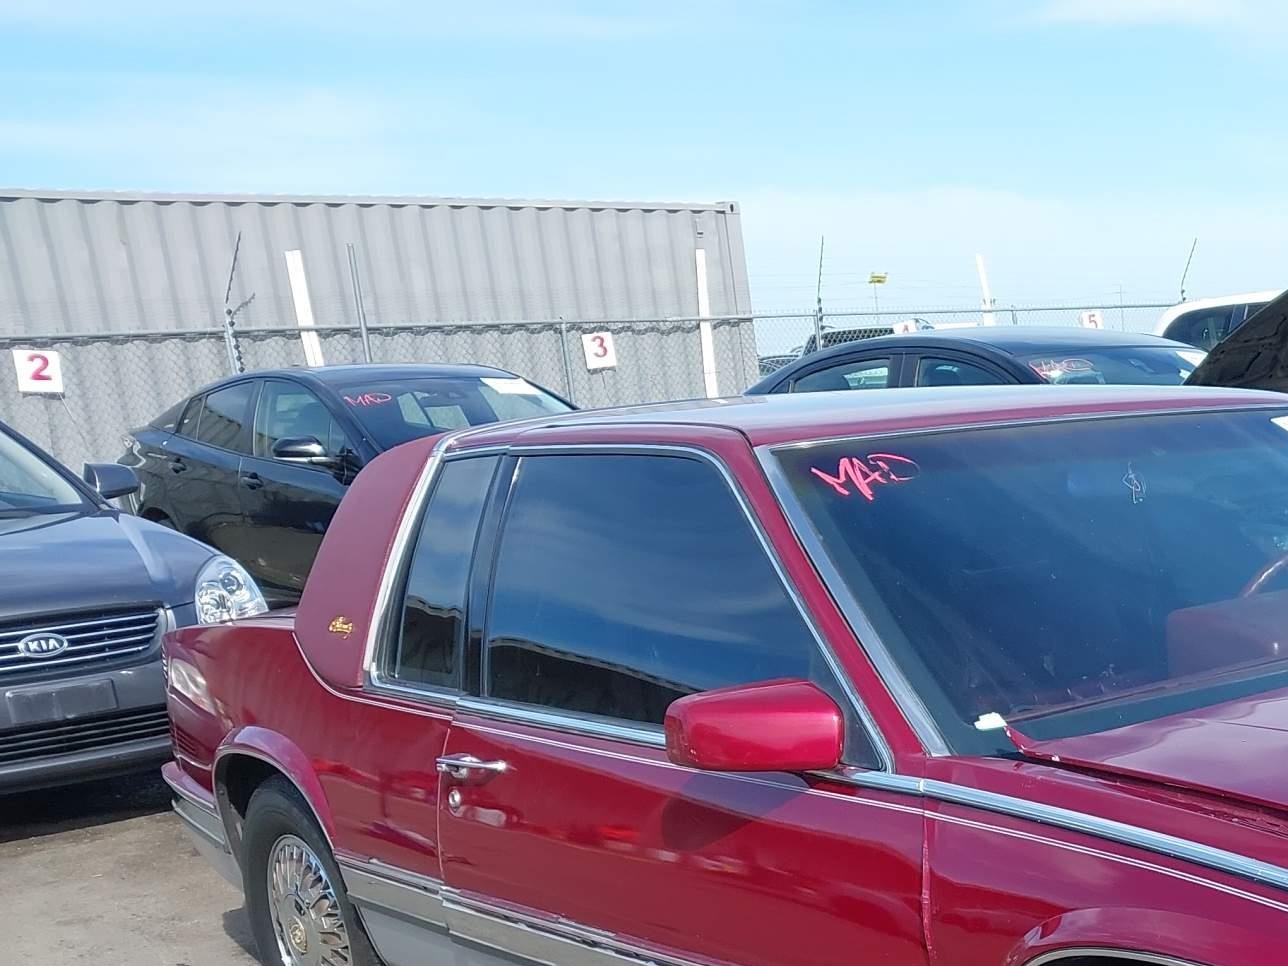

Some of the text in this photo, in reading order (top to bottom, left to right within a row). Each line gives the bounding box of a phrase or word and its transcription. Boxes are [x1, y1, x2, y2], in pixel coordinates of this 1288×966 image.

[592, 335, 608, 358] 3
[28, 354, 52, 380] 2
[811, 453, 920, 501] MAD
[27, 638, 61, 652] KIA
